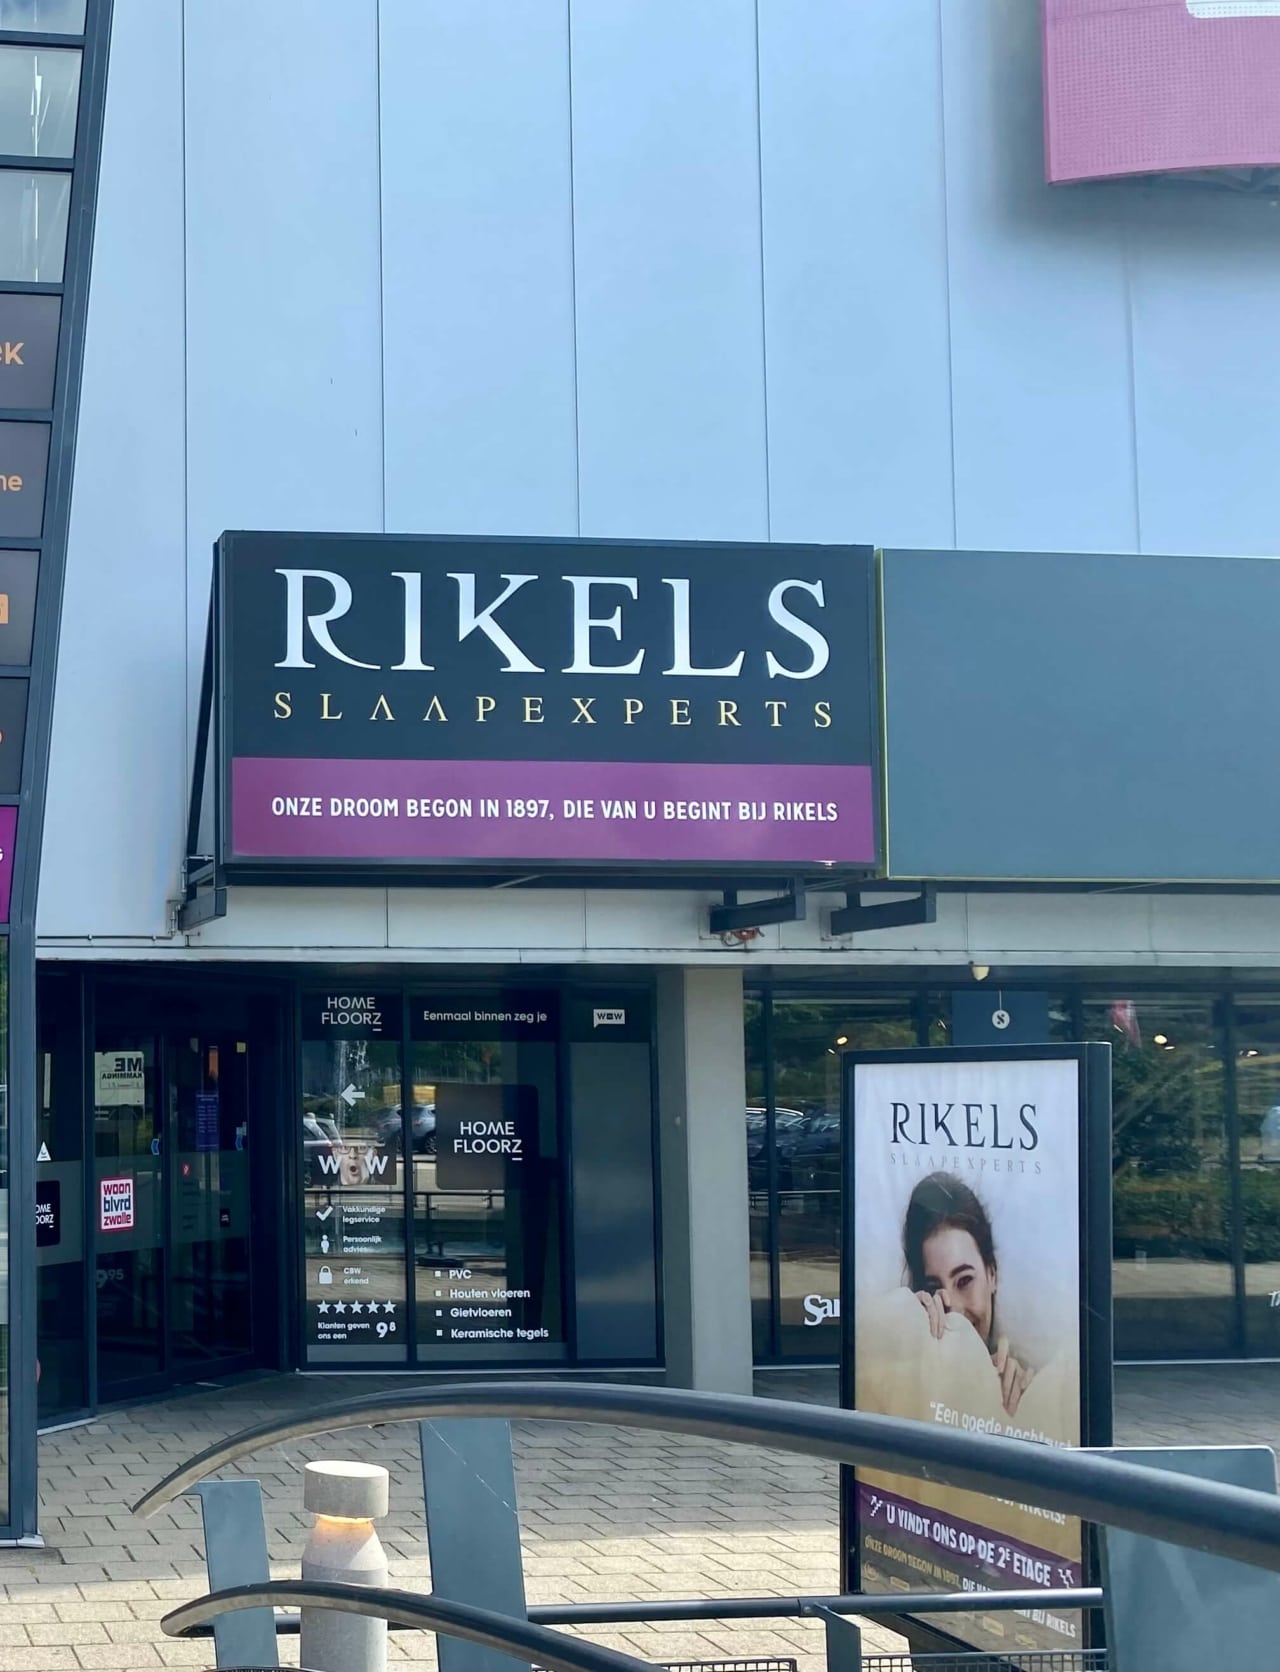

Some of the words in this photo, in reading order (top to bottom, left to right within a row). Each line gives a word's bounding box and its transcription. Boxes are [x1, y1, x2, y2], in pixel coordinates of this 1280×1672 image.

[274, 567, 831, 681] RIKELS
[272, 797, 322, 817] ONZE
[330, 798, 399, 817] DROOM
[406, 798, 472, 818] BEGON
[480, 799, 499, 818] IN
[506, 799, 554, 821] 1897,
[563, 799, 594, 819] DIE
[601, 800, 637, 819] VAN
[644, 801, 656, 819] U
[663, 801, 731, 820] BEGINT
[738, 802, 766, 821] BIJ
[773, 802, 838, 822] RIKELS
[327, 996, 376, 1009] HOME
[321, 1012, 382, 1028] FLOORZ
[423, 1010, 471, 1021] Eenmaal
[474, 1010, 512, 1021] binnen
[514, 1012, 534, 1023] zeg
[536, 1011, 548, 1023] je
[460, 1121, 515, 1136] HOME
[890, 1101, 1039, 1151] RIKELS
[453, 1139, 523, 1157] FLOORZ
[104, 1183, 130, 1195] woon
[36, 1203, 51, 1214] OME
[104, 1195, 131, 1213] blvrd
[35, 1214, 54, 1226] OORZ
[104, 1212, 131, 1226] zwolle
[342, 1216, 380, 1224] legservice
[343, 1235, 382, 1244] Persoonlijk
[449, 1269, 472, 1280] PVC
[450, 1289, 488, 1299] Houten
[491, 1288, 531, 1298] vloeren
[450, 1307, 512, 1318] Gietvloeren
[451, 1328, 514, 1339] Keramische
[516, 1327, 549, 1340] tegels
[886, 1504, 896, 1524] U
[897, 1507, 931, 1538] VINDT
[932, 1522, 957, 1549] ONS
[959, 1532, 976, 1555] OP
[977, 1538, 995, 1564] DE
[1013, 1553, 1051, 1587] ETAGE
